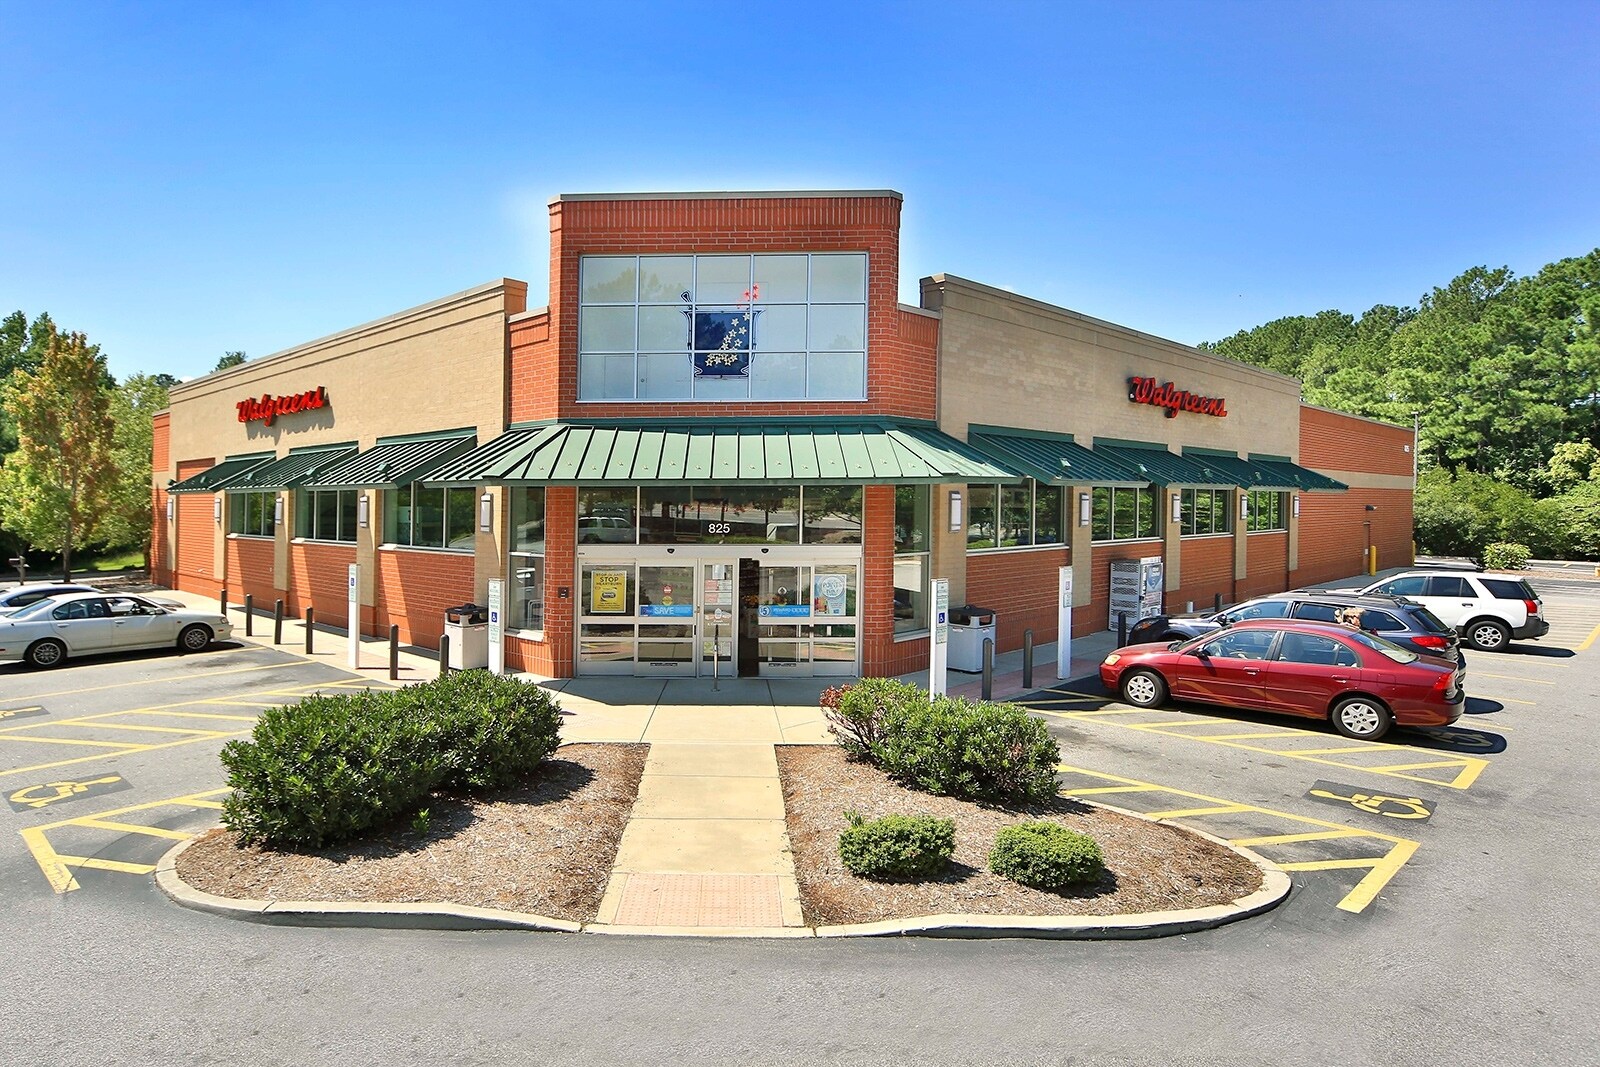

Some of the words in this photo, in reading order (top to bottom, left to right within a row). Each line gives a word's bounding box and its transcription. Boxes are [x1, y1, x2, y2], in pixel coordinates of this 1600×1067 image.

[237, 386, 325, 426] Walgreens
[1130, 377, 1228, 418] Walgreens
[708, 523, 731, 534] 825
[654, 606, 674, 615] SAVE
